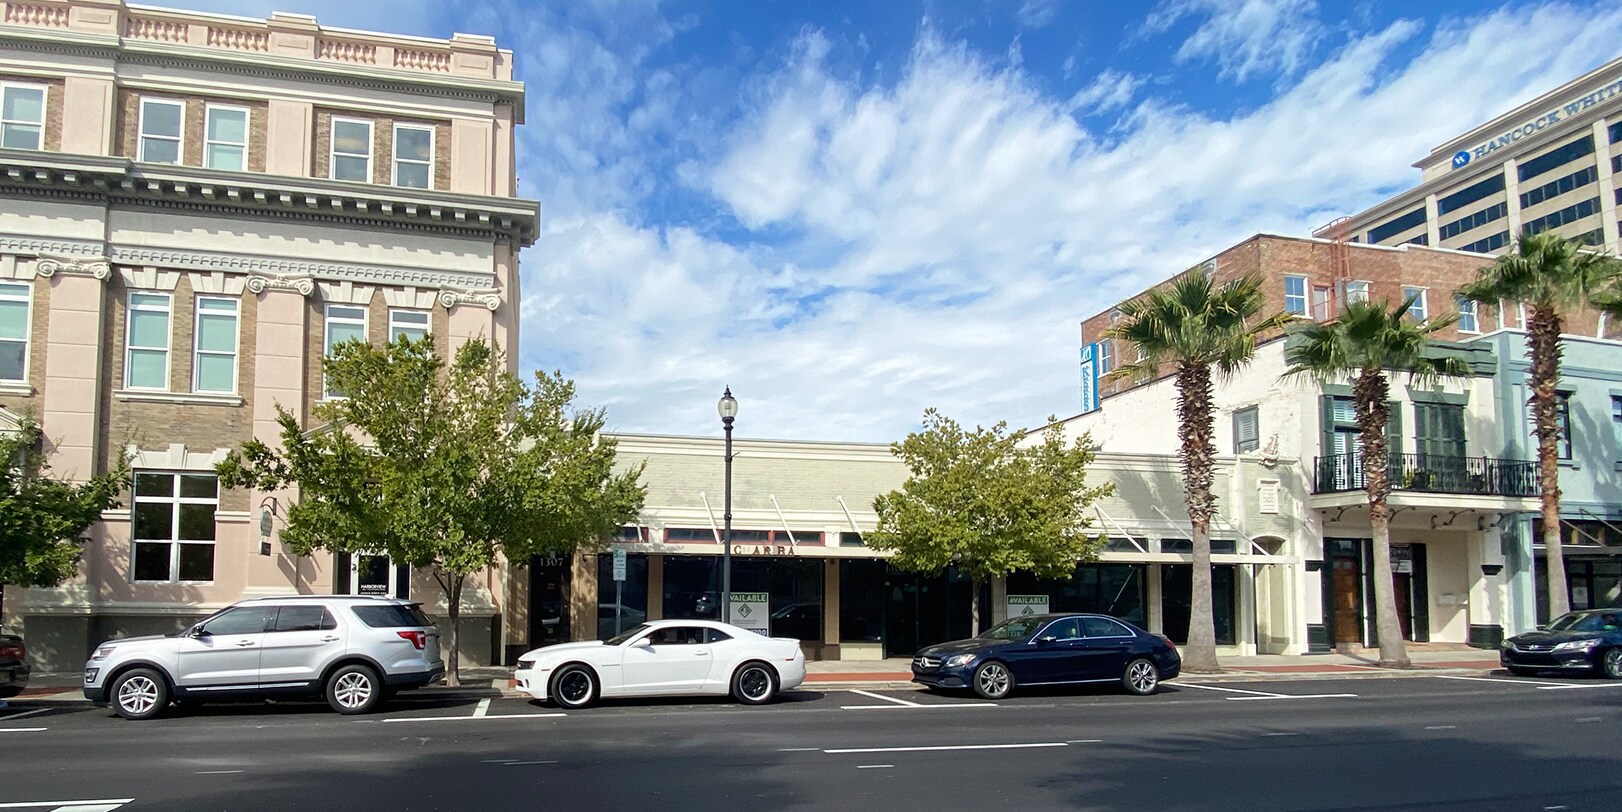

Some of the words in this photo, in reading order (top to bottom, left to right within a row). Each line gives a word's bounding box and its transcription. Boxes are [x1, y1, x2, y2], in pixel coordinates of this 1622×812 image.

[1472, 109, 1561, 160] HANCOCK
[540, 557, 563, 567] 1307
[730, 594, 766, 602] VAILABLE
